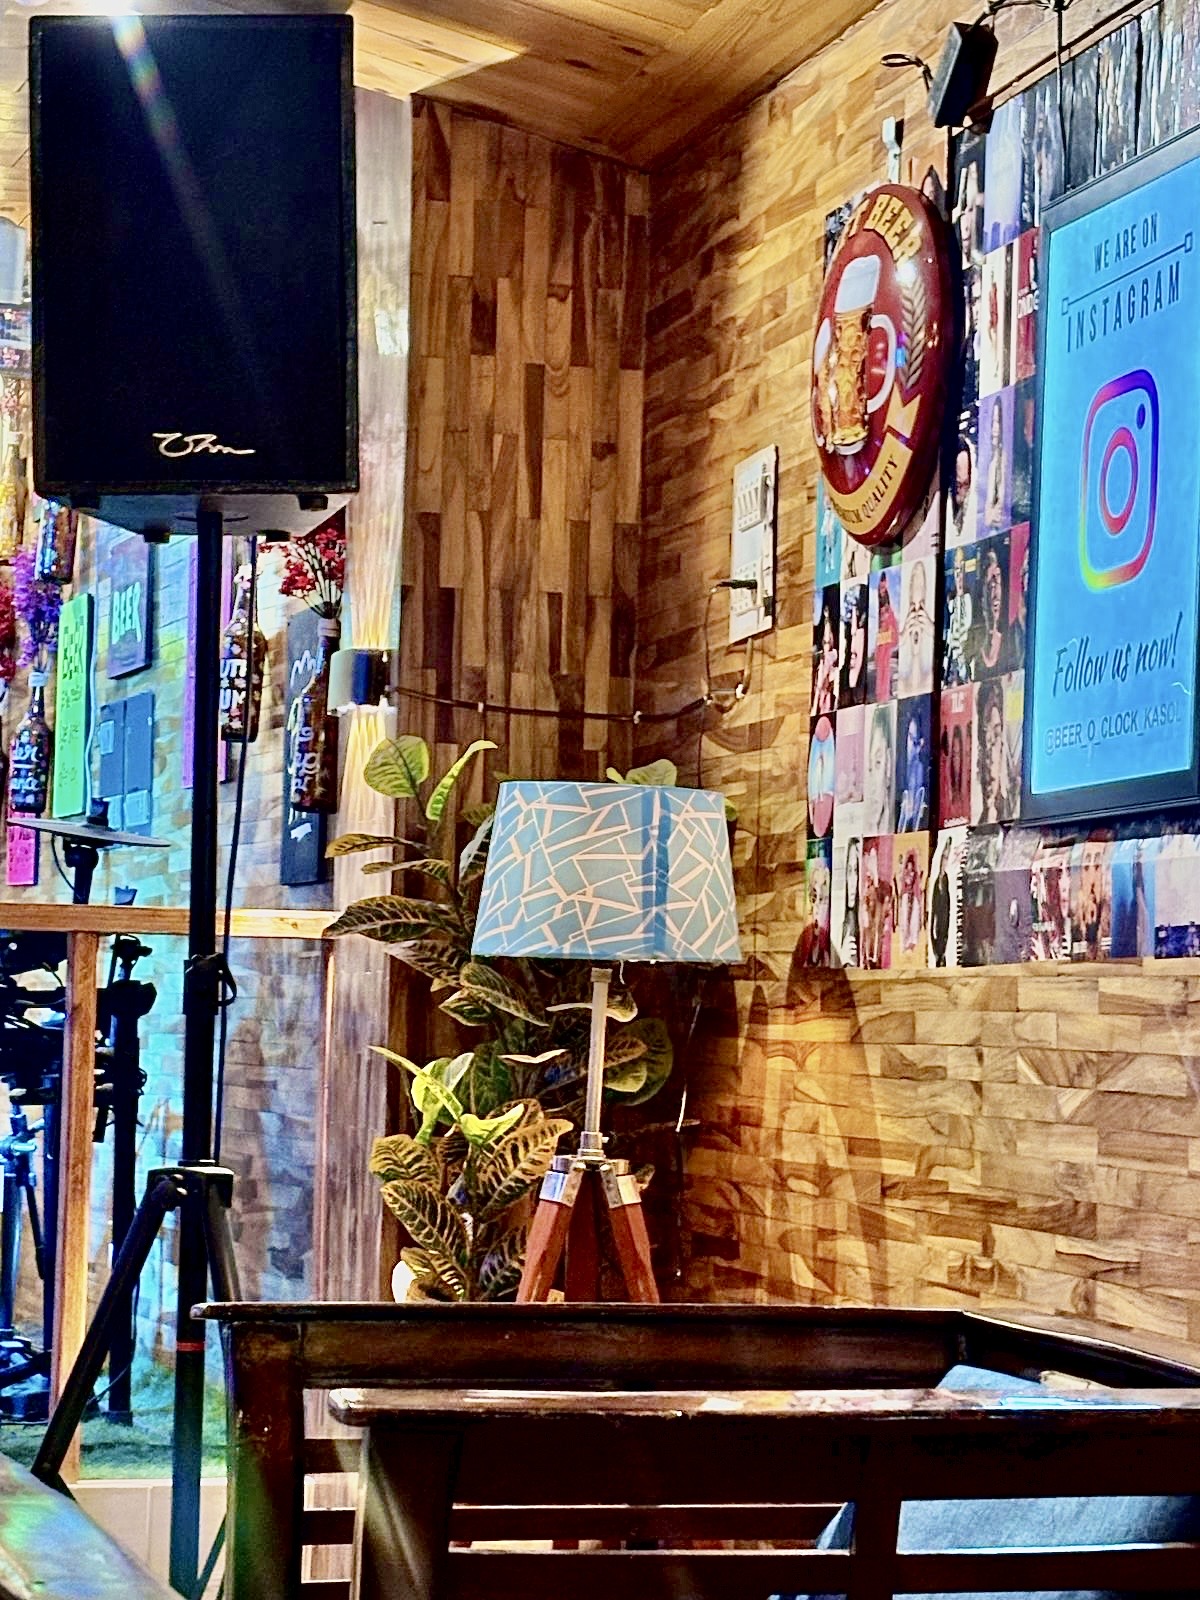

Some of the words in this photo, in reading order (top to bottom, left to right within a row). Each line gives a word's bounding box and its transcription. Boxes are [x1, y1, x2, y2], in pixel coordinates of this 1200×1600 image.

[863, 194, 923, 264] BEER
[1094, 239, 1109, 273] WE
[1115, 224, 1137, 263] ARE
[1142, 212, 1158, 248] ON
[1067, 261, 1180, 353] INSTAGRAM
[861, 453, 898, 519] QUALITY
[112, 581, 142, 645] BEER
[1053, 635, 1109, 697] Follow
[1112, 643, 1132, 682] us
[1135, 611, 1183, 676] now!
